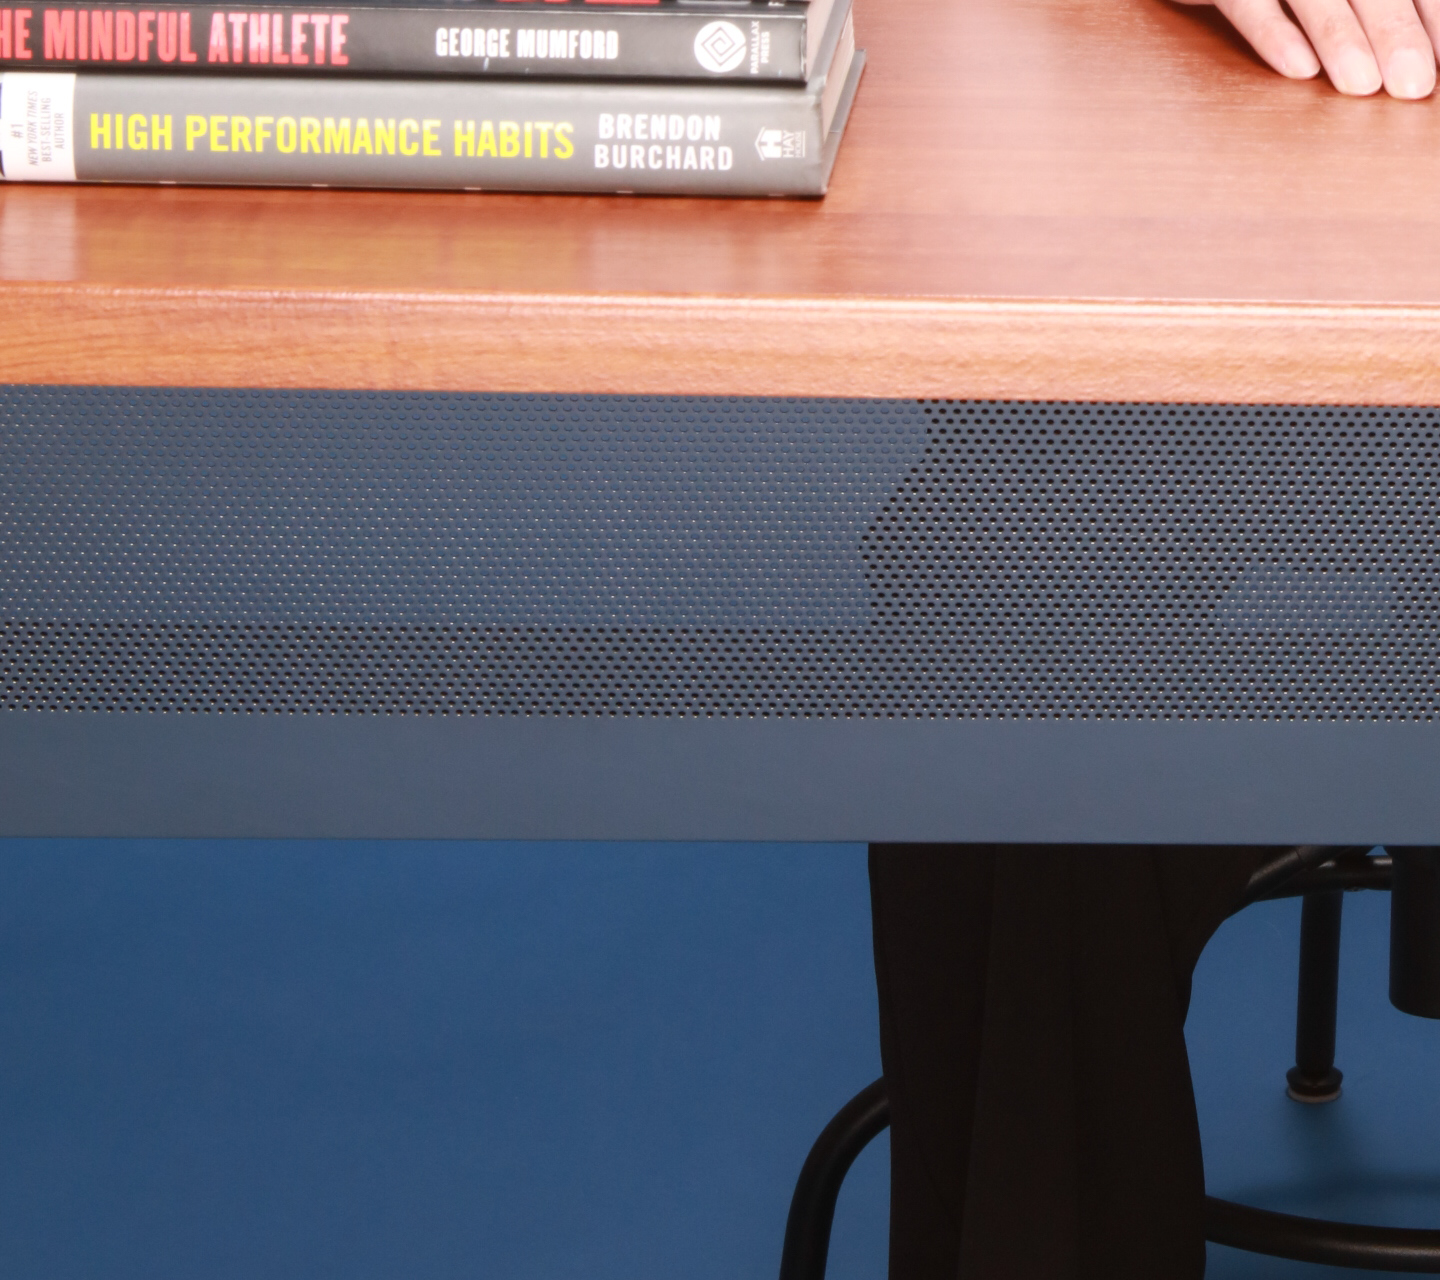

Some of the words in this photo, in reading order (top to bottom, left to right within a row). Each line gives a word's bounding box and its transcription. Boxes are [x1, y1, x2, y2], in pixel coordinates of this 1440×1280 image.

[43, 9, 197, 62] MINDFUL
[208, 12, 350, 66] ATHLETE
[435, 27, 510, 58] GEORGE
[516, 28, 619, 60] MUMFORD
[750, 21, 760, 74] PARALLAX
[760, 31, 770, 63] PRESS
[26, 90, 38, 118] TIMES
[26, 120, 38, 144] YORK
[40, 97, 52, 163] BEST-SELLING
[54, 112, 65, 149] AUTHOR
[90, 112, 173, 151] HIGH
[185, 114, 443, 157] PERFORMANCE
[454, 119, 575, 160] HABITS
[598, 112, 722, 141] BRENDON
[27, 146, 39, 166] NEW
[593, 143, 734, 171] BURCHARD
[782, 130, 794, 158] HAY
